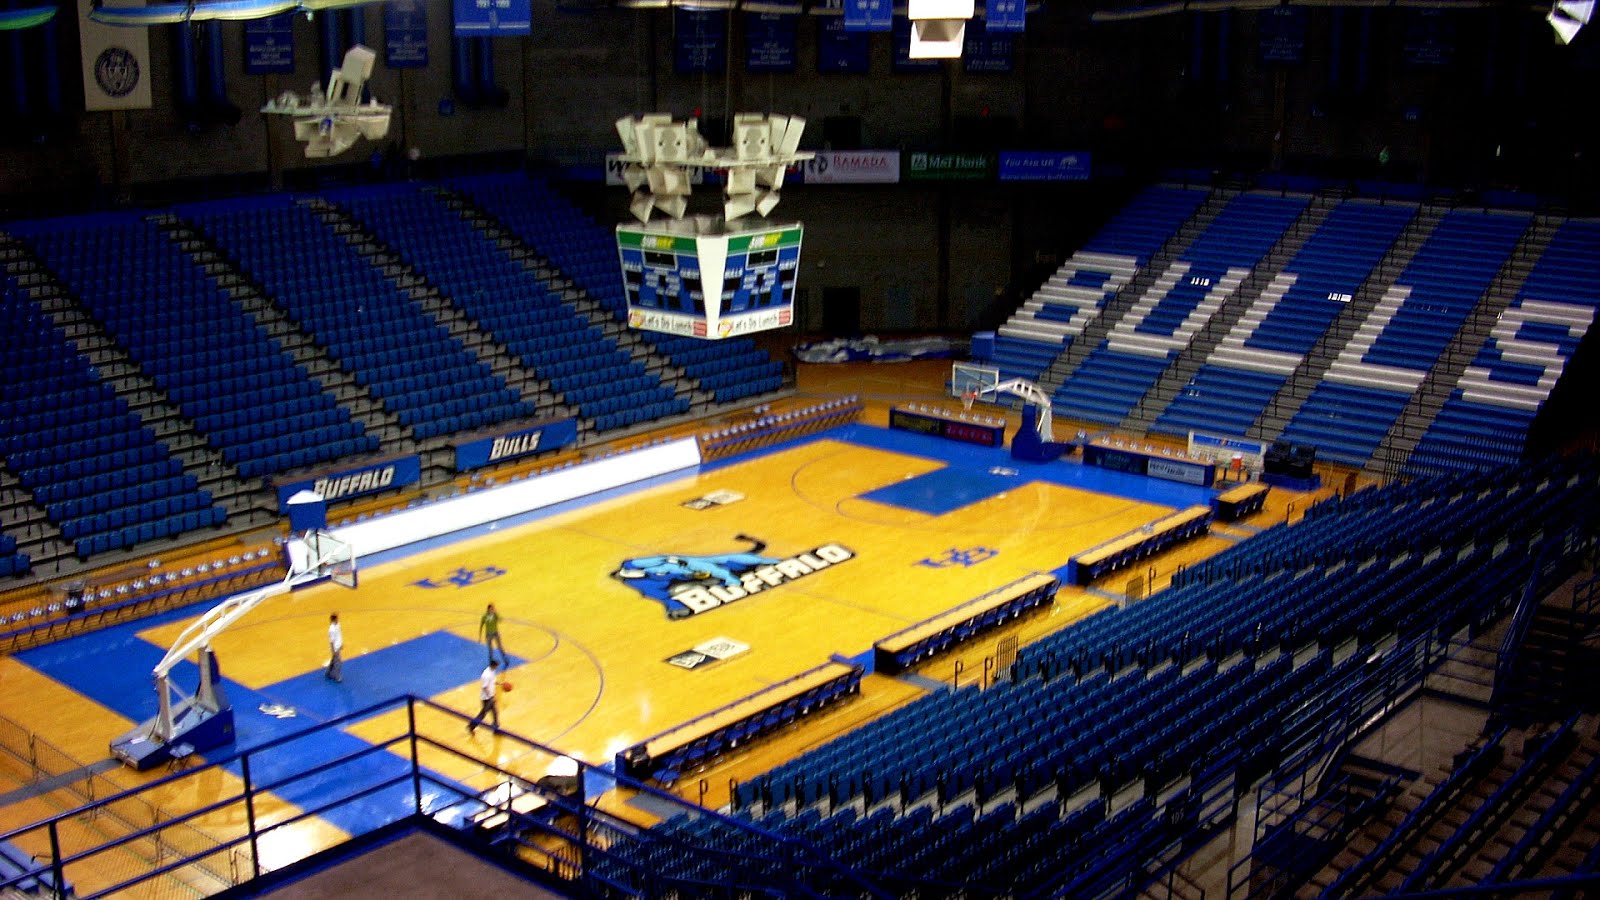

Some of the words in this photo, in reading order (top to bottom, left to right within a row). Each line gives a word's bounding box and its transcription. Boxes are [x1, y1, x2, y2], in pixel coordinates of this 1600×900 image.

[998, 251, 1595, 412] BULLS
[489, 430, 542, 461] BULLS
[313, 465, 396, 500] BUFFALO
[671, 543, 854, 614] BUFFALO
